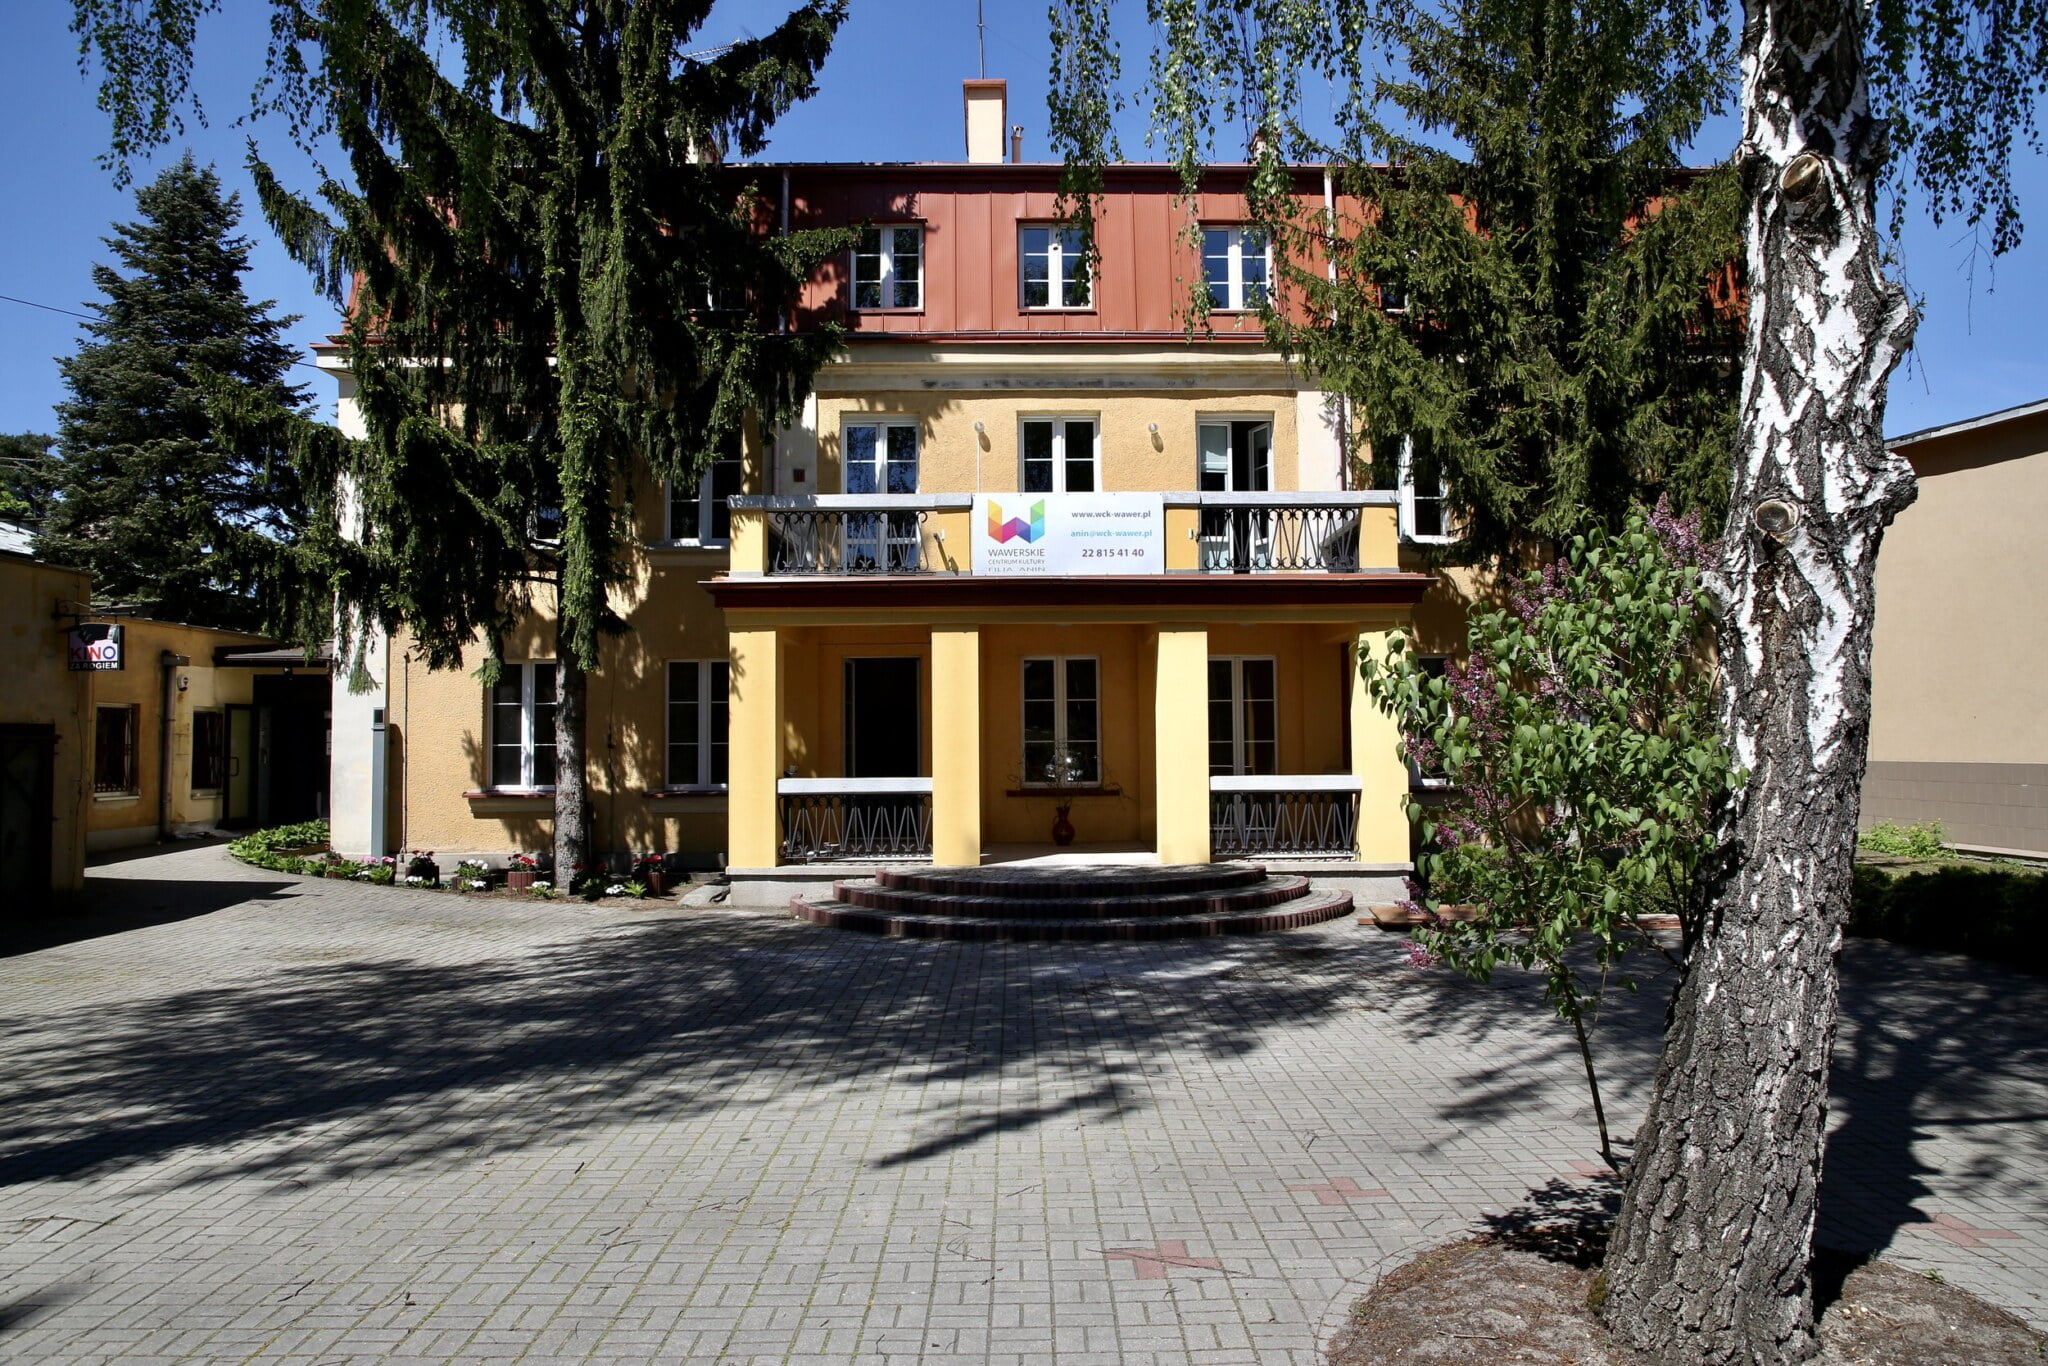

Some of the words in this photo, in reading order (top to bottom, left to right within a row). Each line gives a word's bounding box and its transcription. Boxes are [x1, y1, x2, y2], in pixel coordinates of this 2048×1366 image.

[1071, 510, 1151, 519] www.wck-wawer.pl
[1070, 529, 1153, 539] anin@wck-wawer.pl
[988, 548, 1045, 557] WAWERSKIE
[1082, 548, 1094, 558] 22
[1096, 548, 1115, 558] 815
[1117, 548, 1129, 558] 41
[1131, 548, 1145, 558] 40
[70, 646, 116, 660] KINO
[82, 661, 118, 670] ROGIEM
